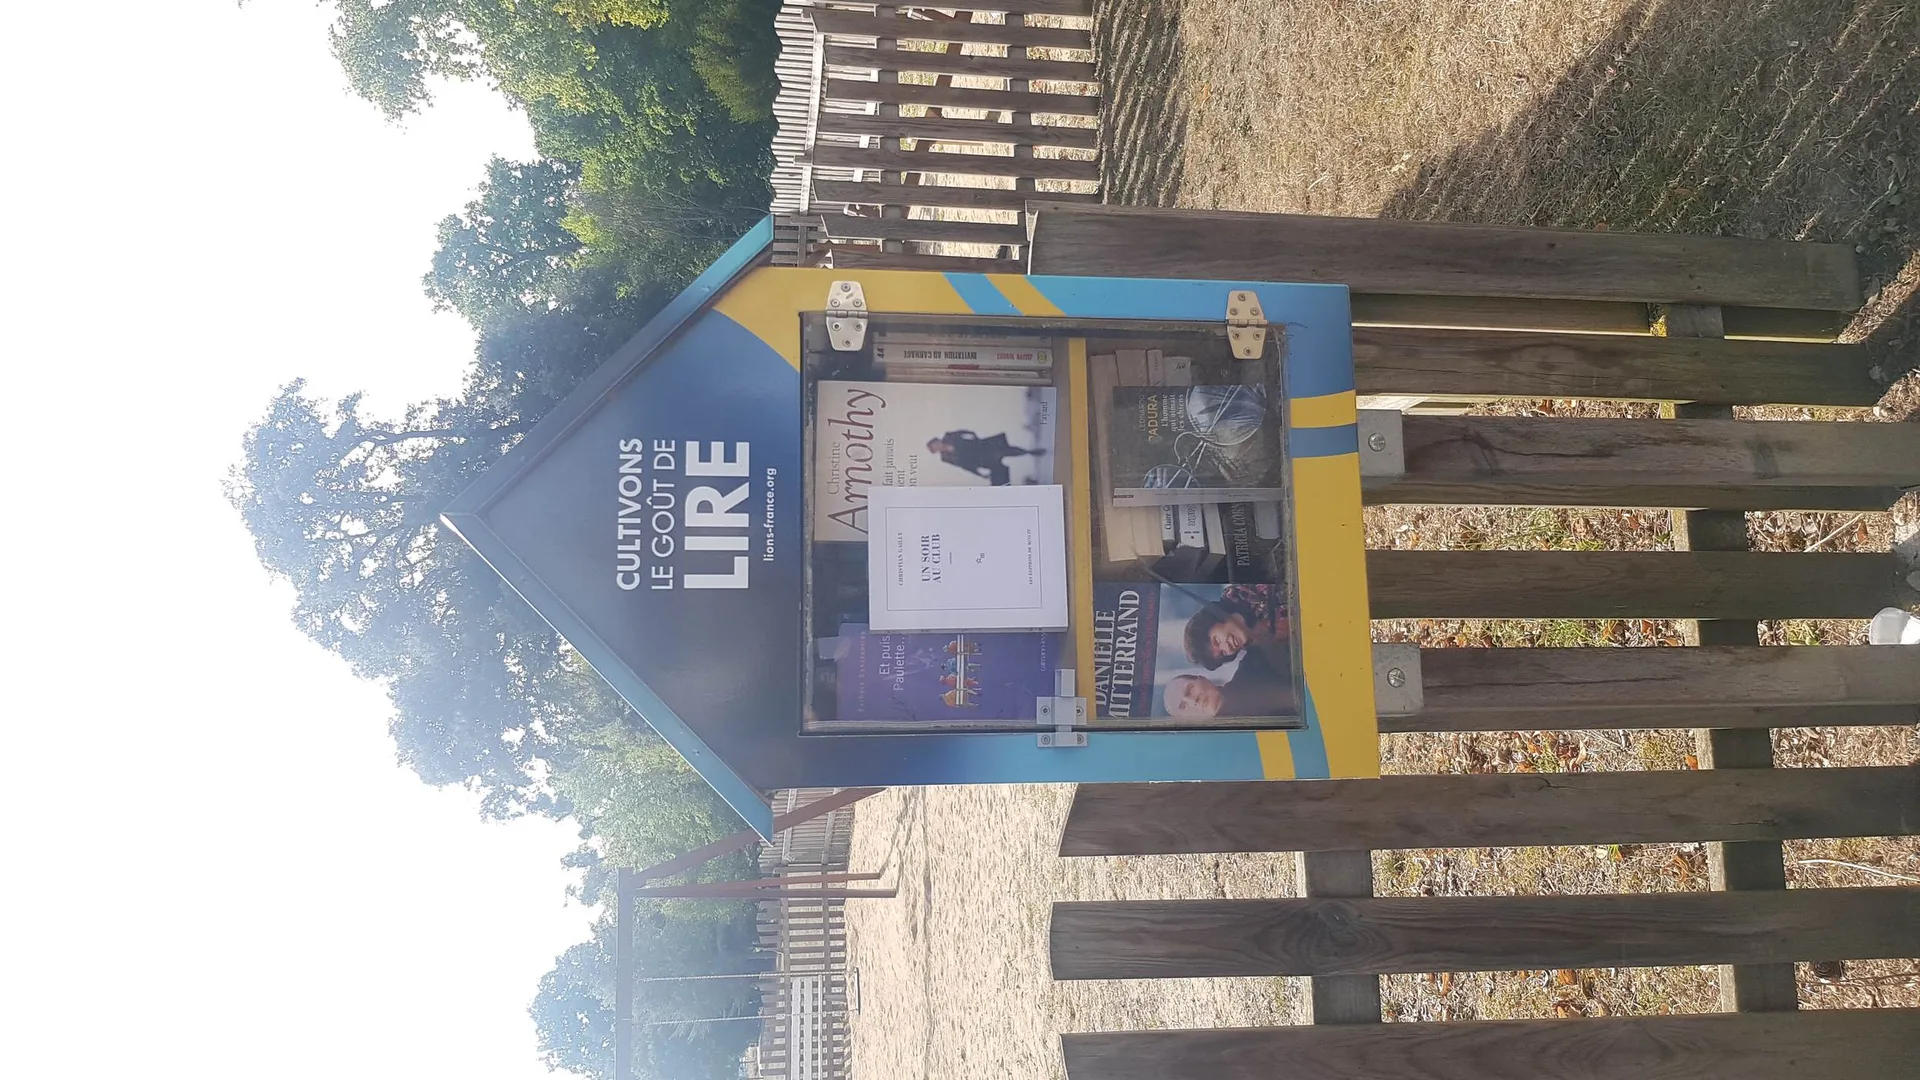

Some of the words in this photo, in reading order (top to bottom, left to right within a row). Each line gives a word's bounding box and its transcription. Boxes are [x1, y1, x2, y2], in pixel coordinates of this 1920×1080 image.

[1040, 402, 1051, 424] Fayard
[1170, 420, 1178, 432] qui
[653, 439, 676, 470] DE
[827, 388, 886, 535] Arnothy
[884, 438, 896, 469] jamais
[908, 454, 918, 474] veut
[826, 442, 841, 495] Christine
[882, 471, 894, 486] fait
[616, 438, 643, 590] CULTIVONS
[646, 478, 676, 558] GOÛT
[684, 440, 750, 589] LIRE
[763, 467, 777, 562] lions-france.org
[1164, 513, 1172, 530] Claire
[920, 535, 930, 562] SOIR
[931, 534, 940, 564] CLUB
[1234, 528, 1250, 566] PATRICIA
[651, 566, 674, 590] LE
[921, 566, 930, 582] UN
[932, 567, 941, 584] AU
[880, 635, 892, 659] puis
[1094, 610, 1116, 706] DANIELLE
[879, 662, 890, 675] Et
